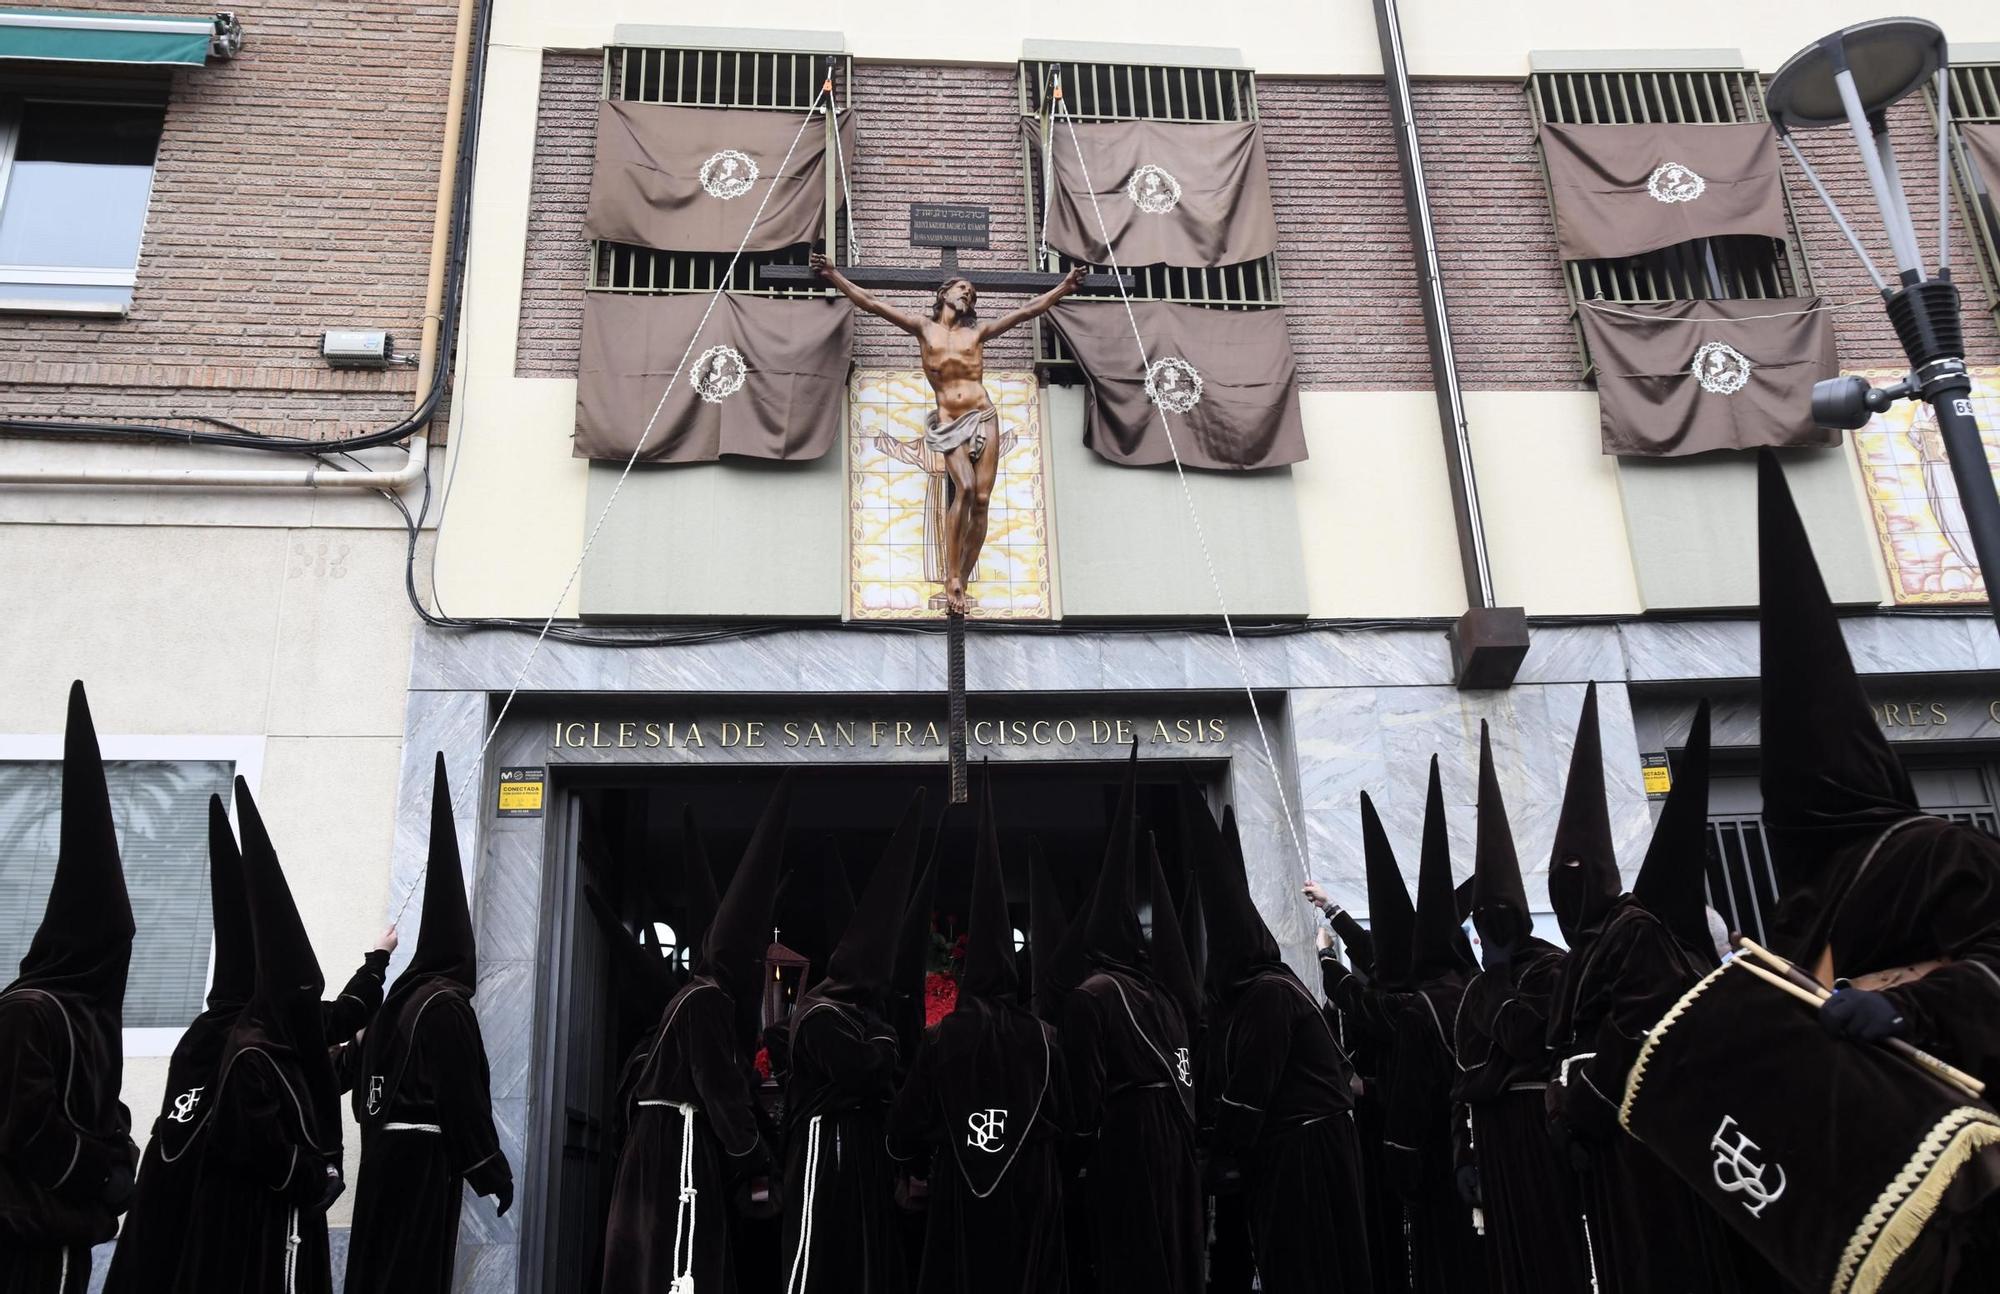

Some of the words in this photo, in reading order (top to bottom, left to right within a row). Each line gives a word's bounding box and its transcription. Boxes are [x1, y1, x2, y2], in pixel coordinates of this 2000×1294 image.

[554, 722, 705, 748] IGLESIA
[720, 722, 766, 748] DE
[783, 721, 857, 748] SAN
[870, 720, 1076, 748] FRACISCO
[1090, 719, 1135, 745] DE
[1150, 718, 1226, 744] ASIS
